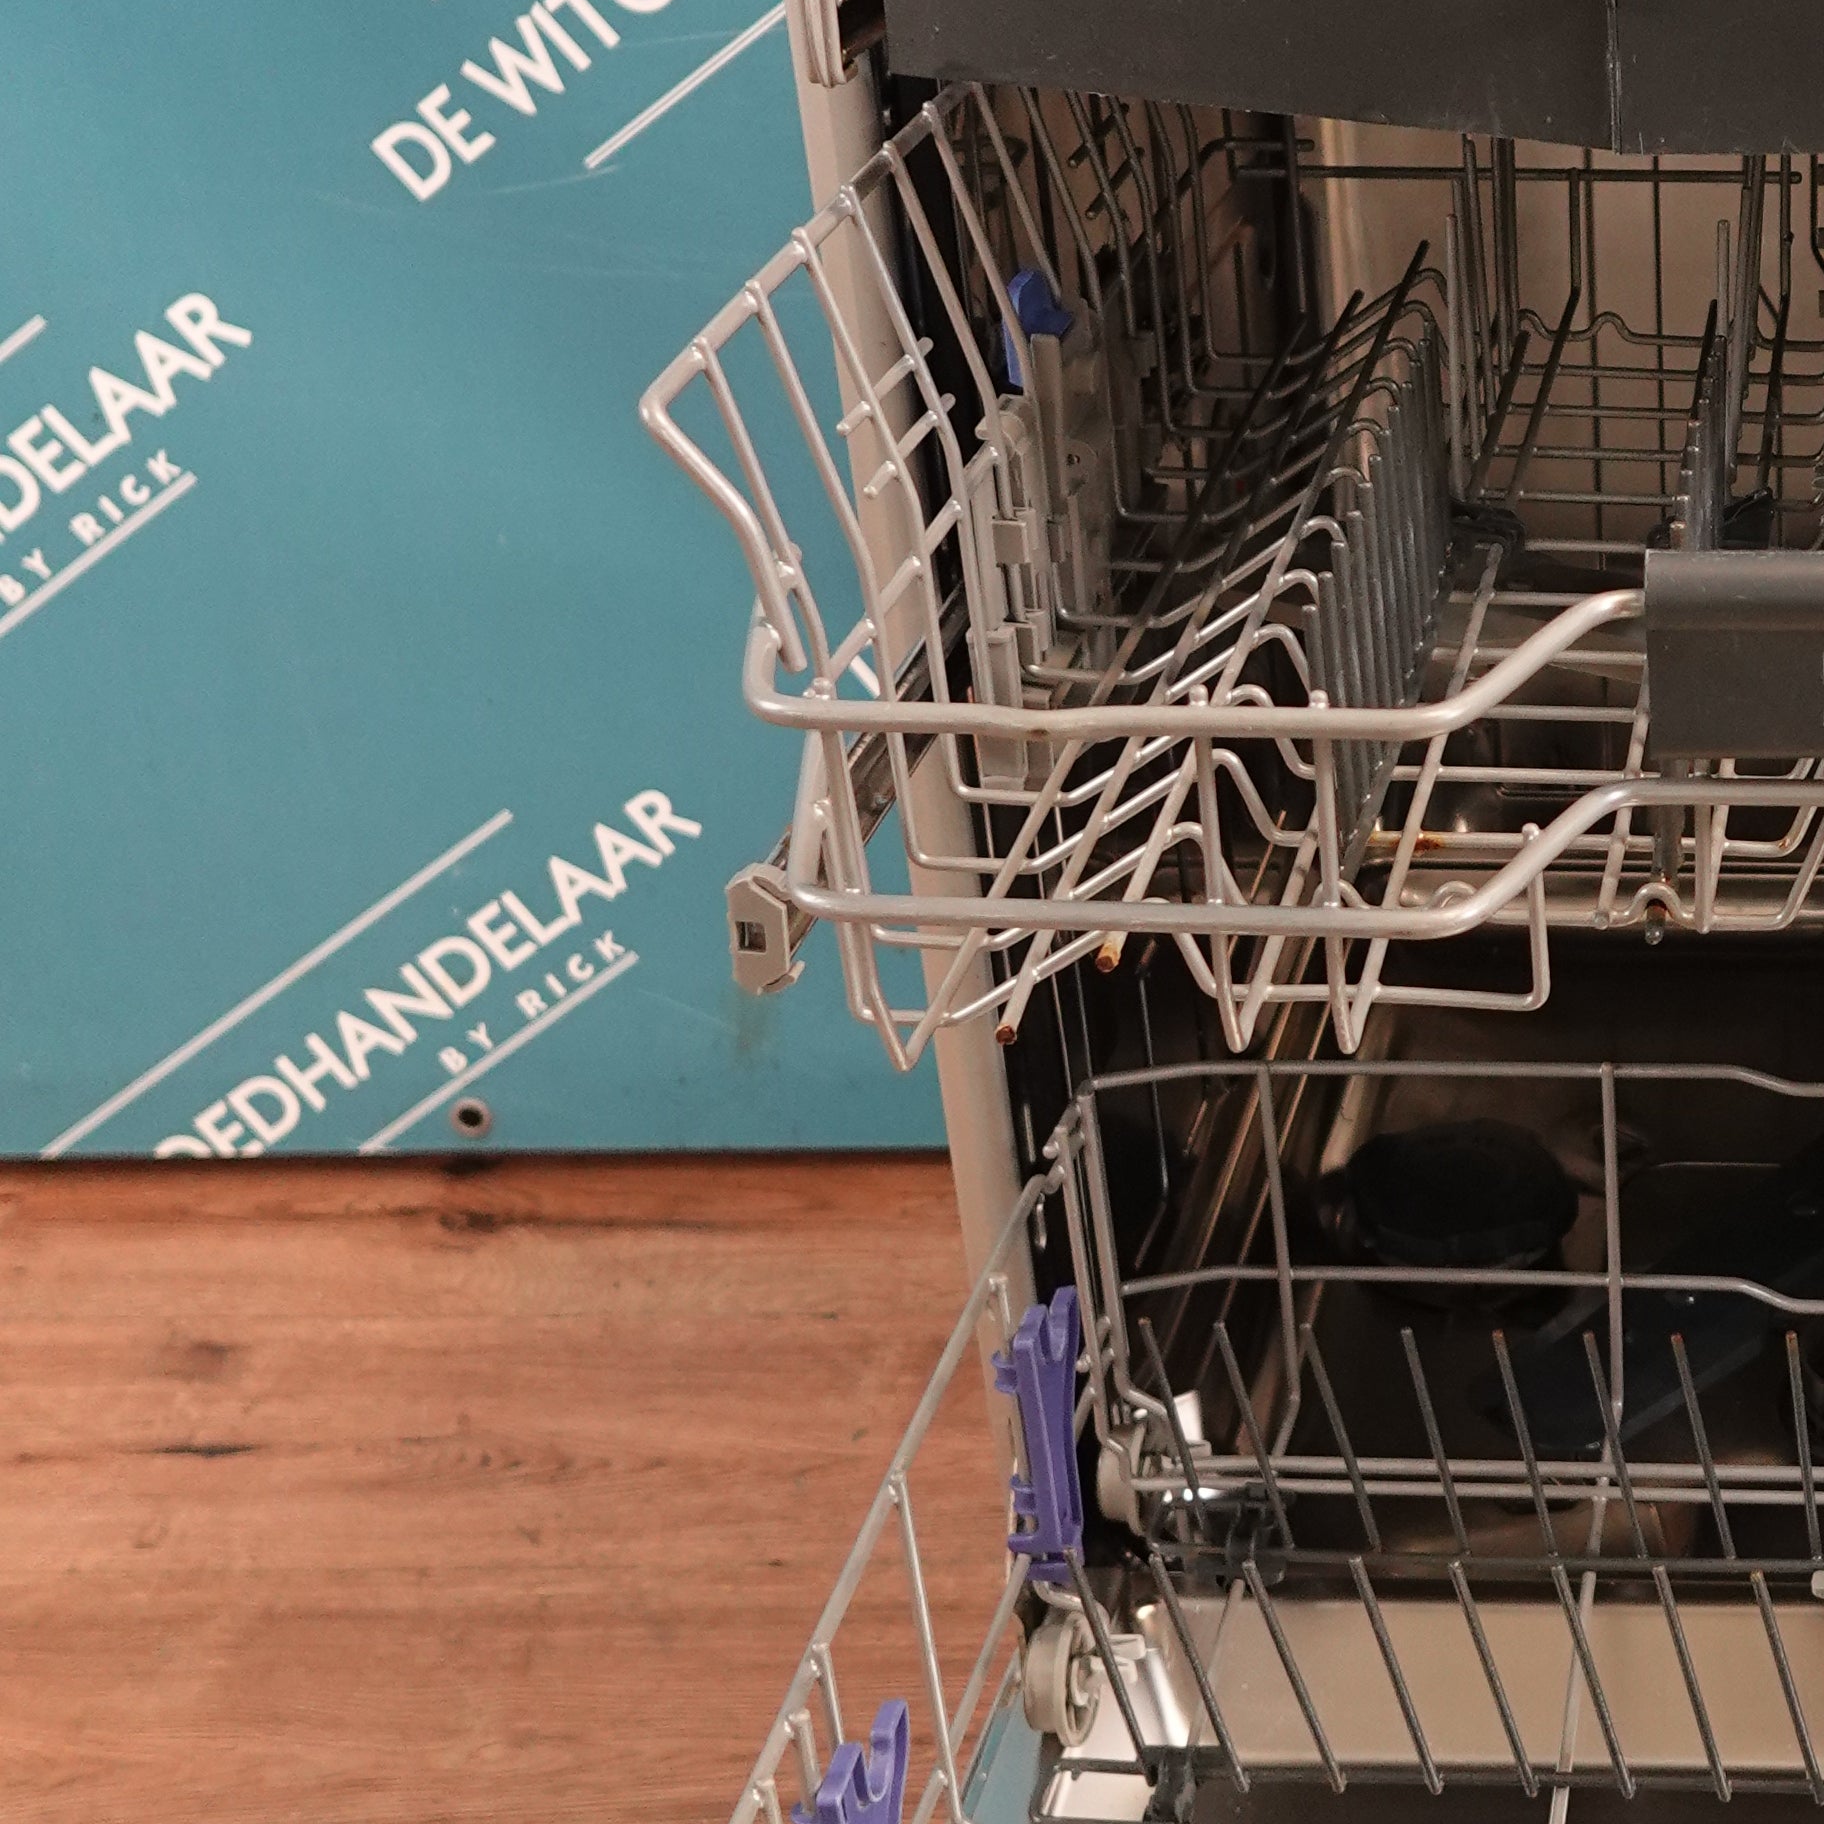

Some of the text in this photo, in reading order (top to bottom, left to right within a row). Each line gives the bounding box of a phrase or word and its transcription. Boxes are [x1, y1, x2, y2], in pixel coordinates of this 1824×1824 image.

[370, 83, 496, 202] DE
[0, 292, 253, 546] DELAAR
[69, 449, 181, 545] RICK
[439, 930, 626, 1075] BY RICK
